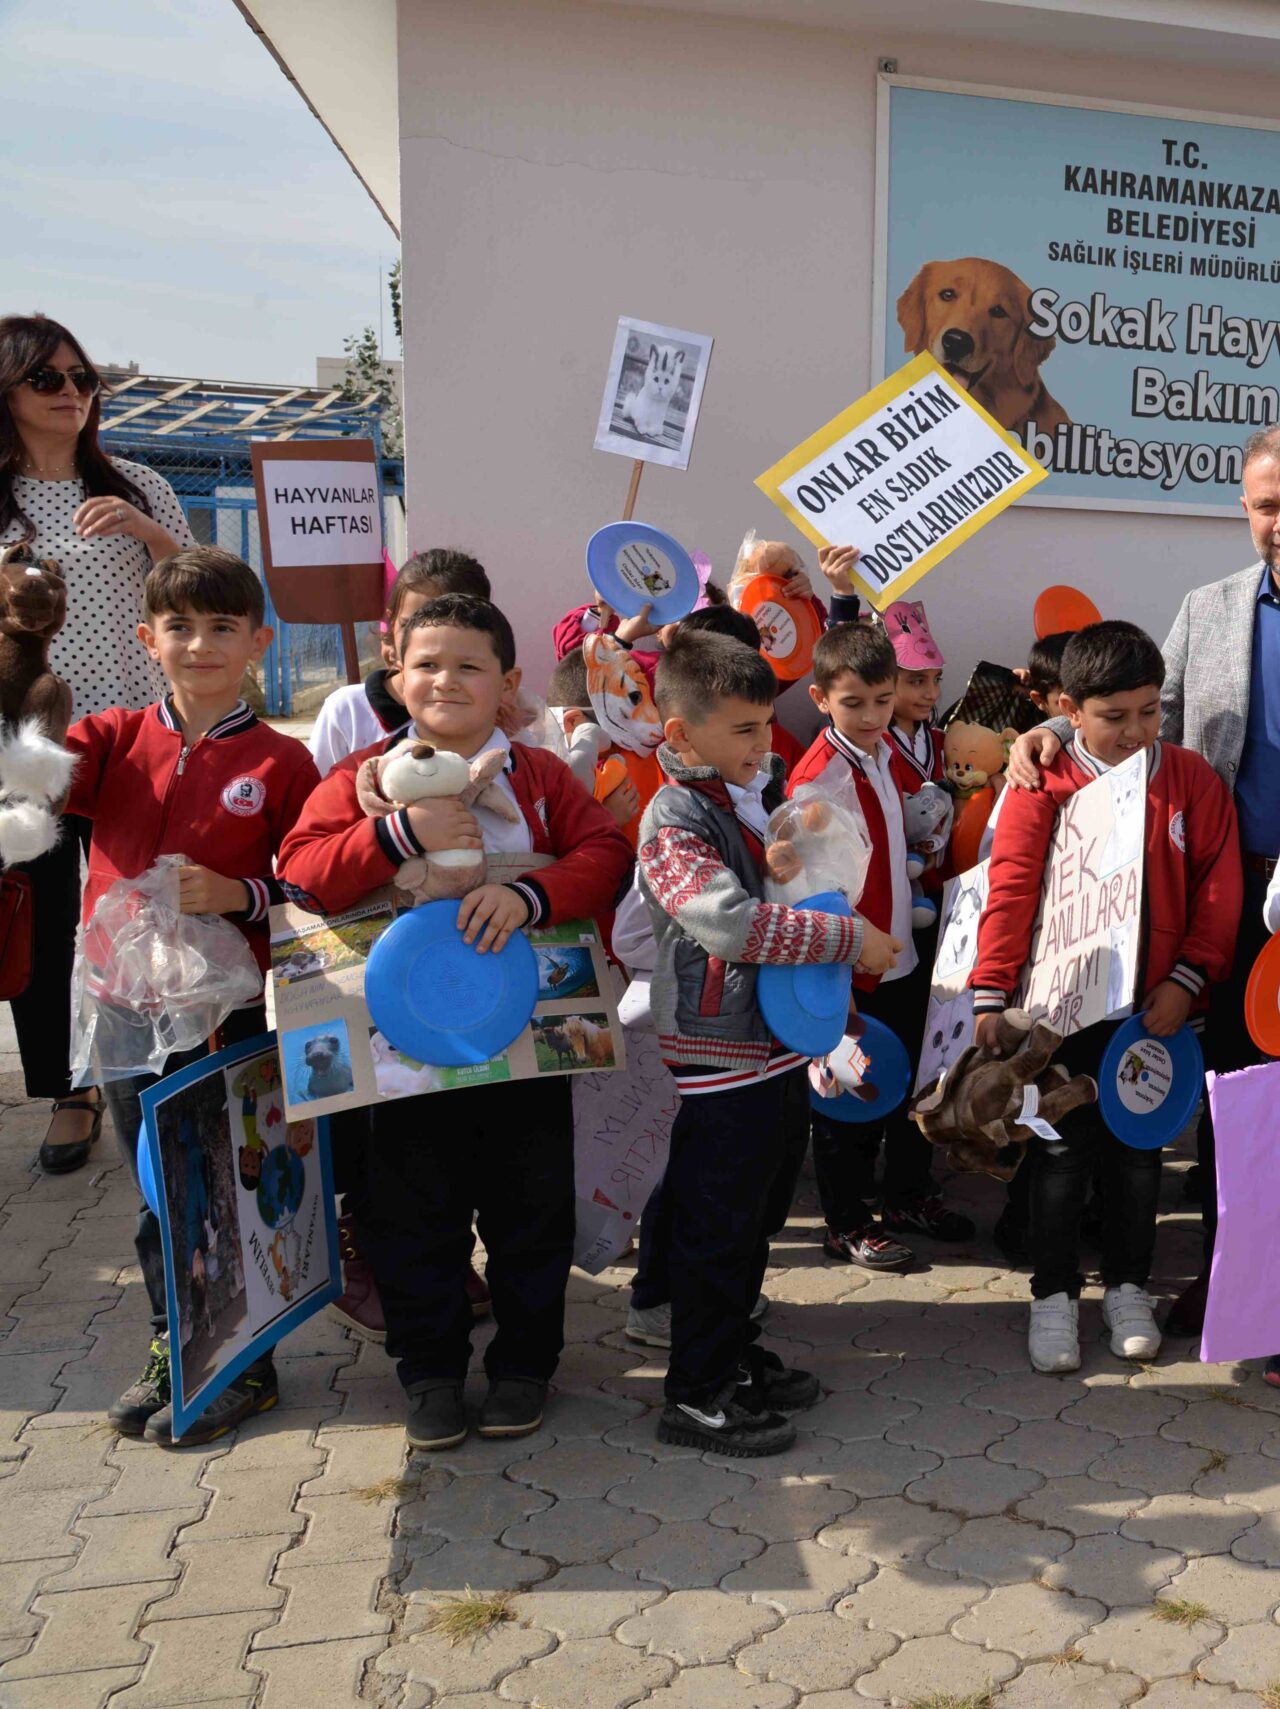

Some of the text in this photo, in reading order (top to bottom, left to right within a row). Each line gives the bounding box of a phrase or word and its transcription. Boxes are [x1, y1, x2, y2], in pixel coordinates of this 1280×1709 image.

[1162, 139, 1208, 170] T.C.
[1106, 206, 1256, 249] BELEDİYESİ
[1047, 240, 1117, 268] SAĞLIK
[1122, 243, 1183, 276] İŞLERİ
[1027, 288, 1177, 354] Sokak
[1132, 367, 1279, 426] Bakım
[797, 384, 961, 514] ONLAR BİZİM
[1006, 421, 1242, 490] bilitasyon
[275, 488, 375, 504] HAYVANLAR
[857, 447, 952, 524] EN SADIK
[291, 516, 373, 535] HAFTASI
[860, 450, 1025, 584] DOSTLARIMIZDIR
